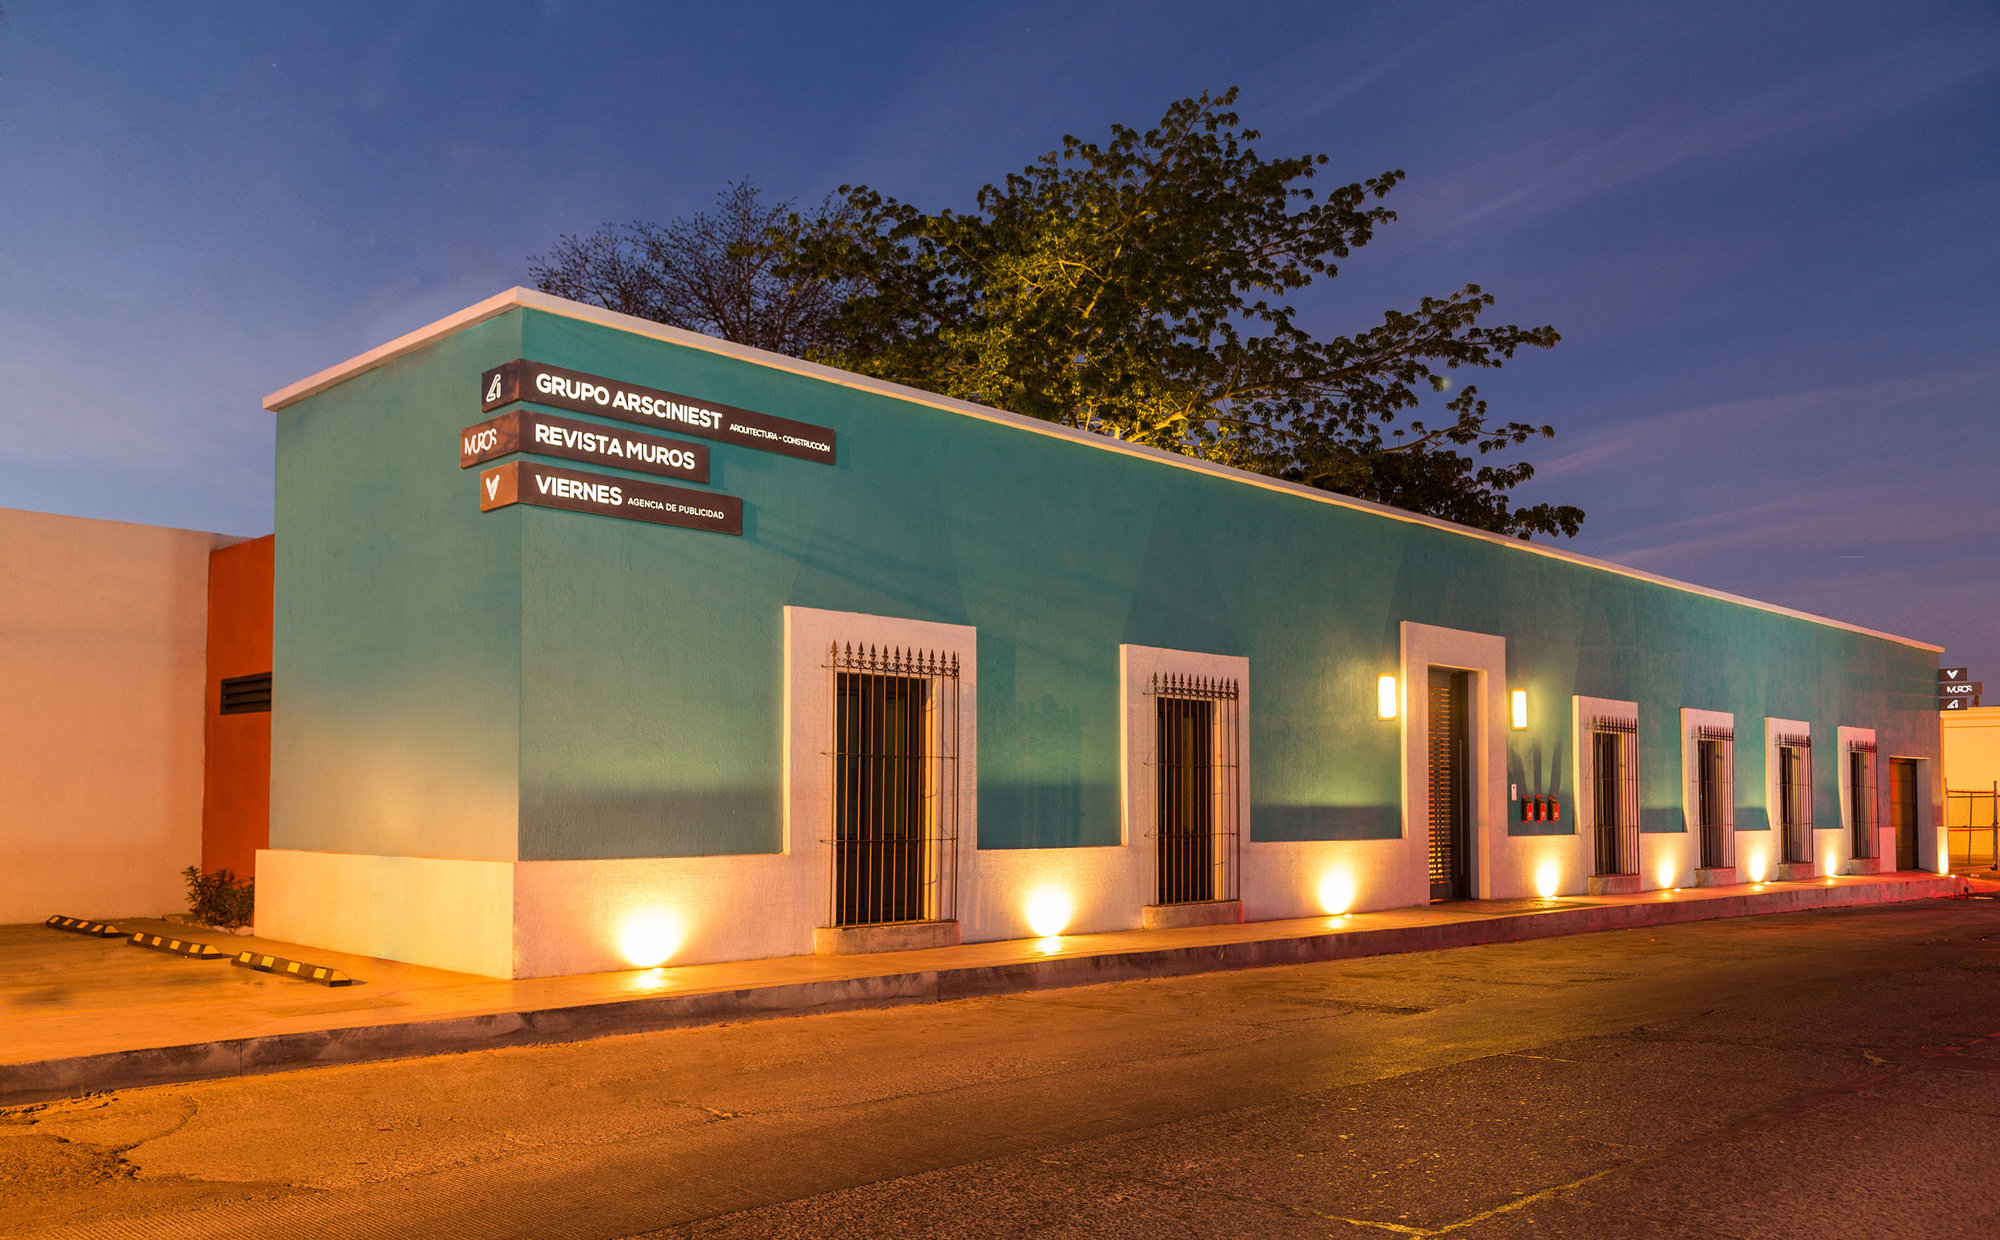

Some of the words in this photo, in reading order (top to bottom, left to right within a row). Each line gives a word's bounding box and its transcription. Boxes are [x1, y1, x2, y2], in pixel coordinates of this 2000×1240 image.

[536, 373, 610, 406] GRUPO
[612, 391, 722, 429] ARSCINIEST
[729, 423, 778, 441] ARQUITECTURA
[783, 435, 830, 452] CONSTRUCCIÓN
[464, 428, 497, 455] MUROS
[535, 423, 624, 458] REVISTA
[626, 440, 695, 470] MUROS
[535, 474, 623, 505] VIERNES
[628, 497, 664, 511] AGENCIA
[666, 503, 677, 512] DE
[679, 504, 724, 520] PUBLICIDAD
